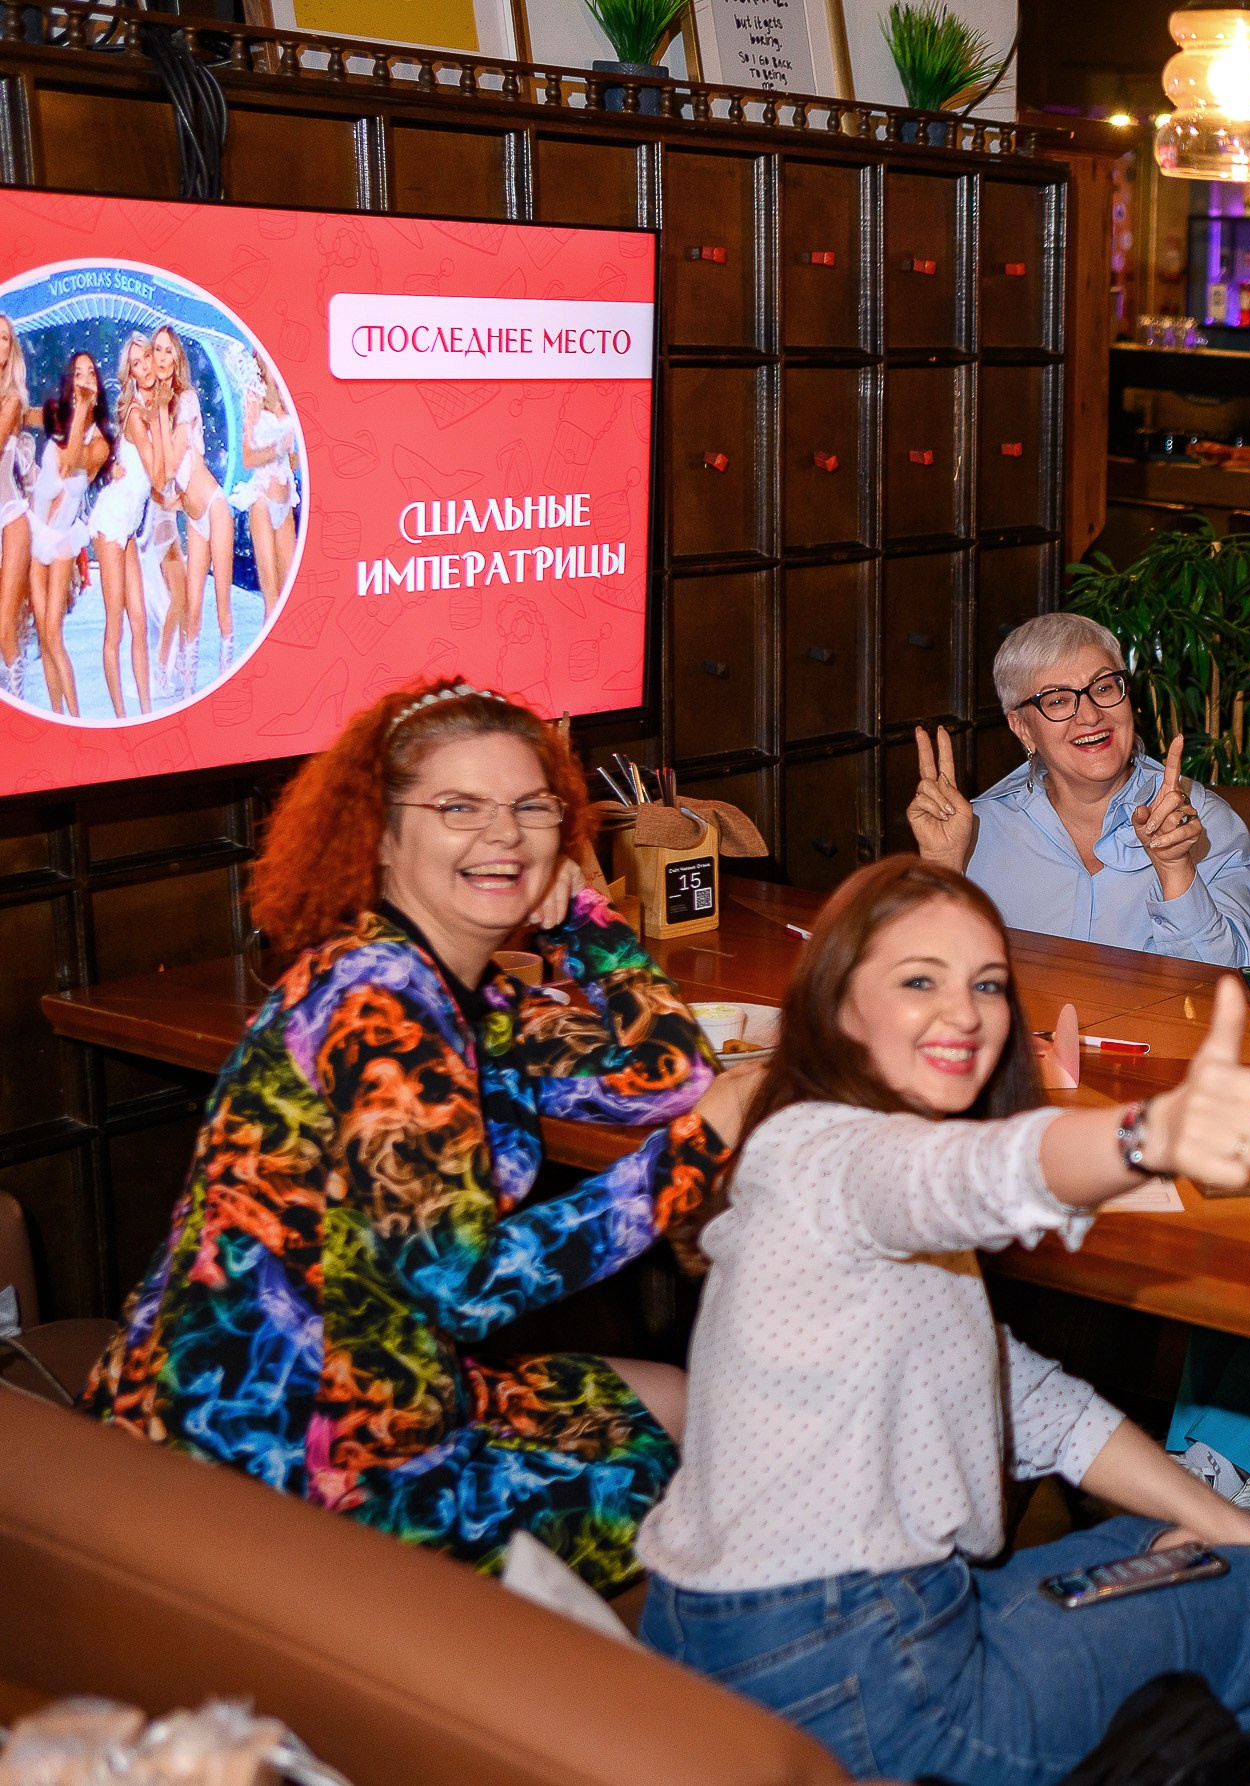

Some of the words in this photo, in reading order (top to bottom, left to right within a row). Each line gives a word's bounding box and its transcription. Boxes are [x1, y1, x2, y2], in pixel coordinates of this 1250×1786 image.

[734, 14, 752, 30] but
[754, 16, 762, 30] it
[763, 17, 783, 35] gets
[49, 272, 112, 296] VICTORIA'S
[114, 272, 157, 300] SECRET
[352, 325, 533, 358] ПОСЛЕДНЕЕ
[543, 328, 632, 355] МЕСТО
[400, 494, 591, 544] ШАЛЬНЫЕ
[357, 542, 626, 596] ИМПЕРАТРИЦЫ
[679, 872, 702, 891] 15
